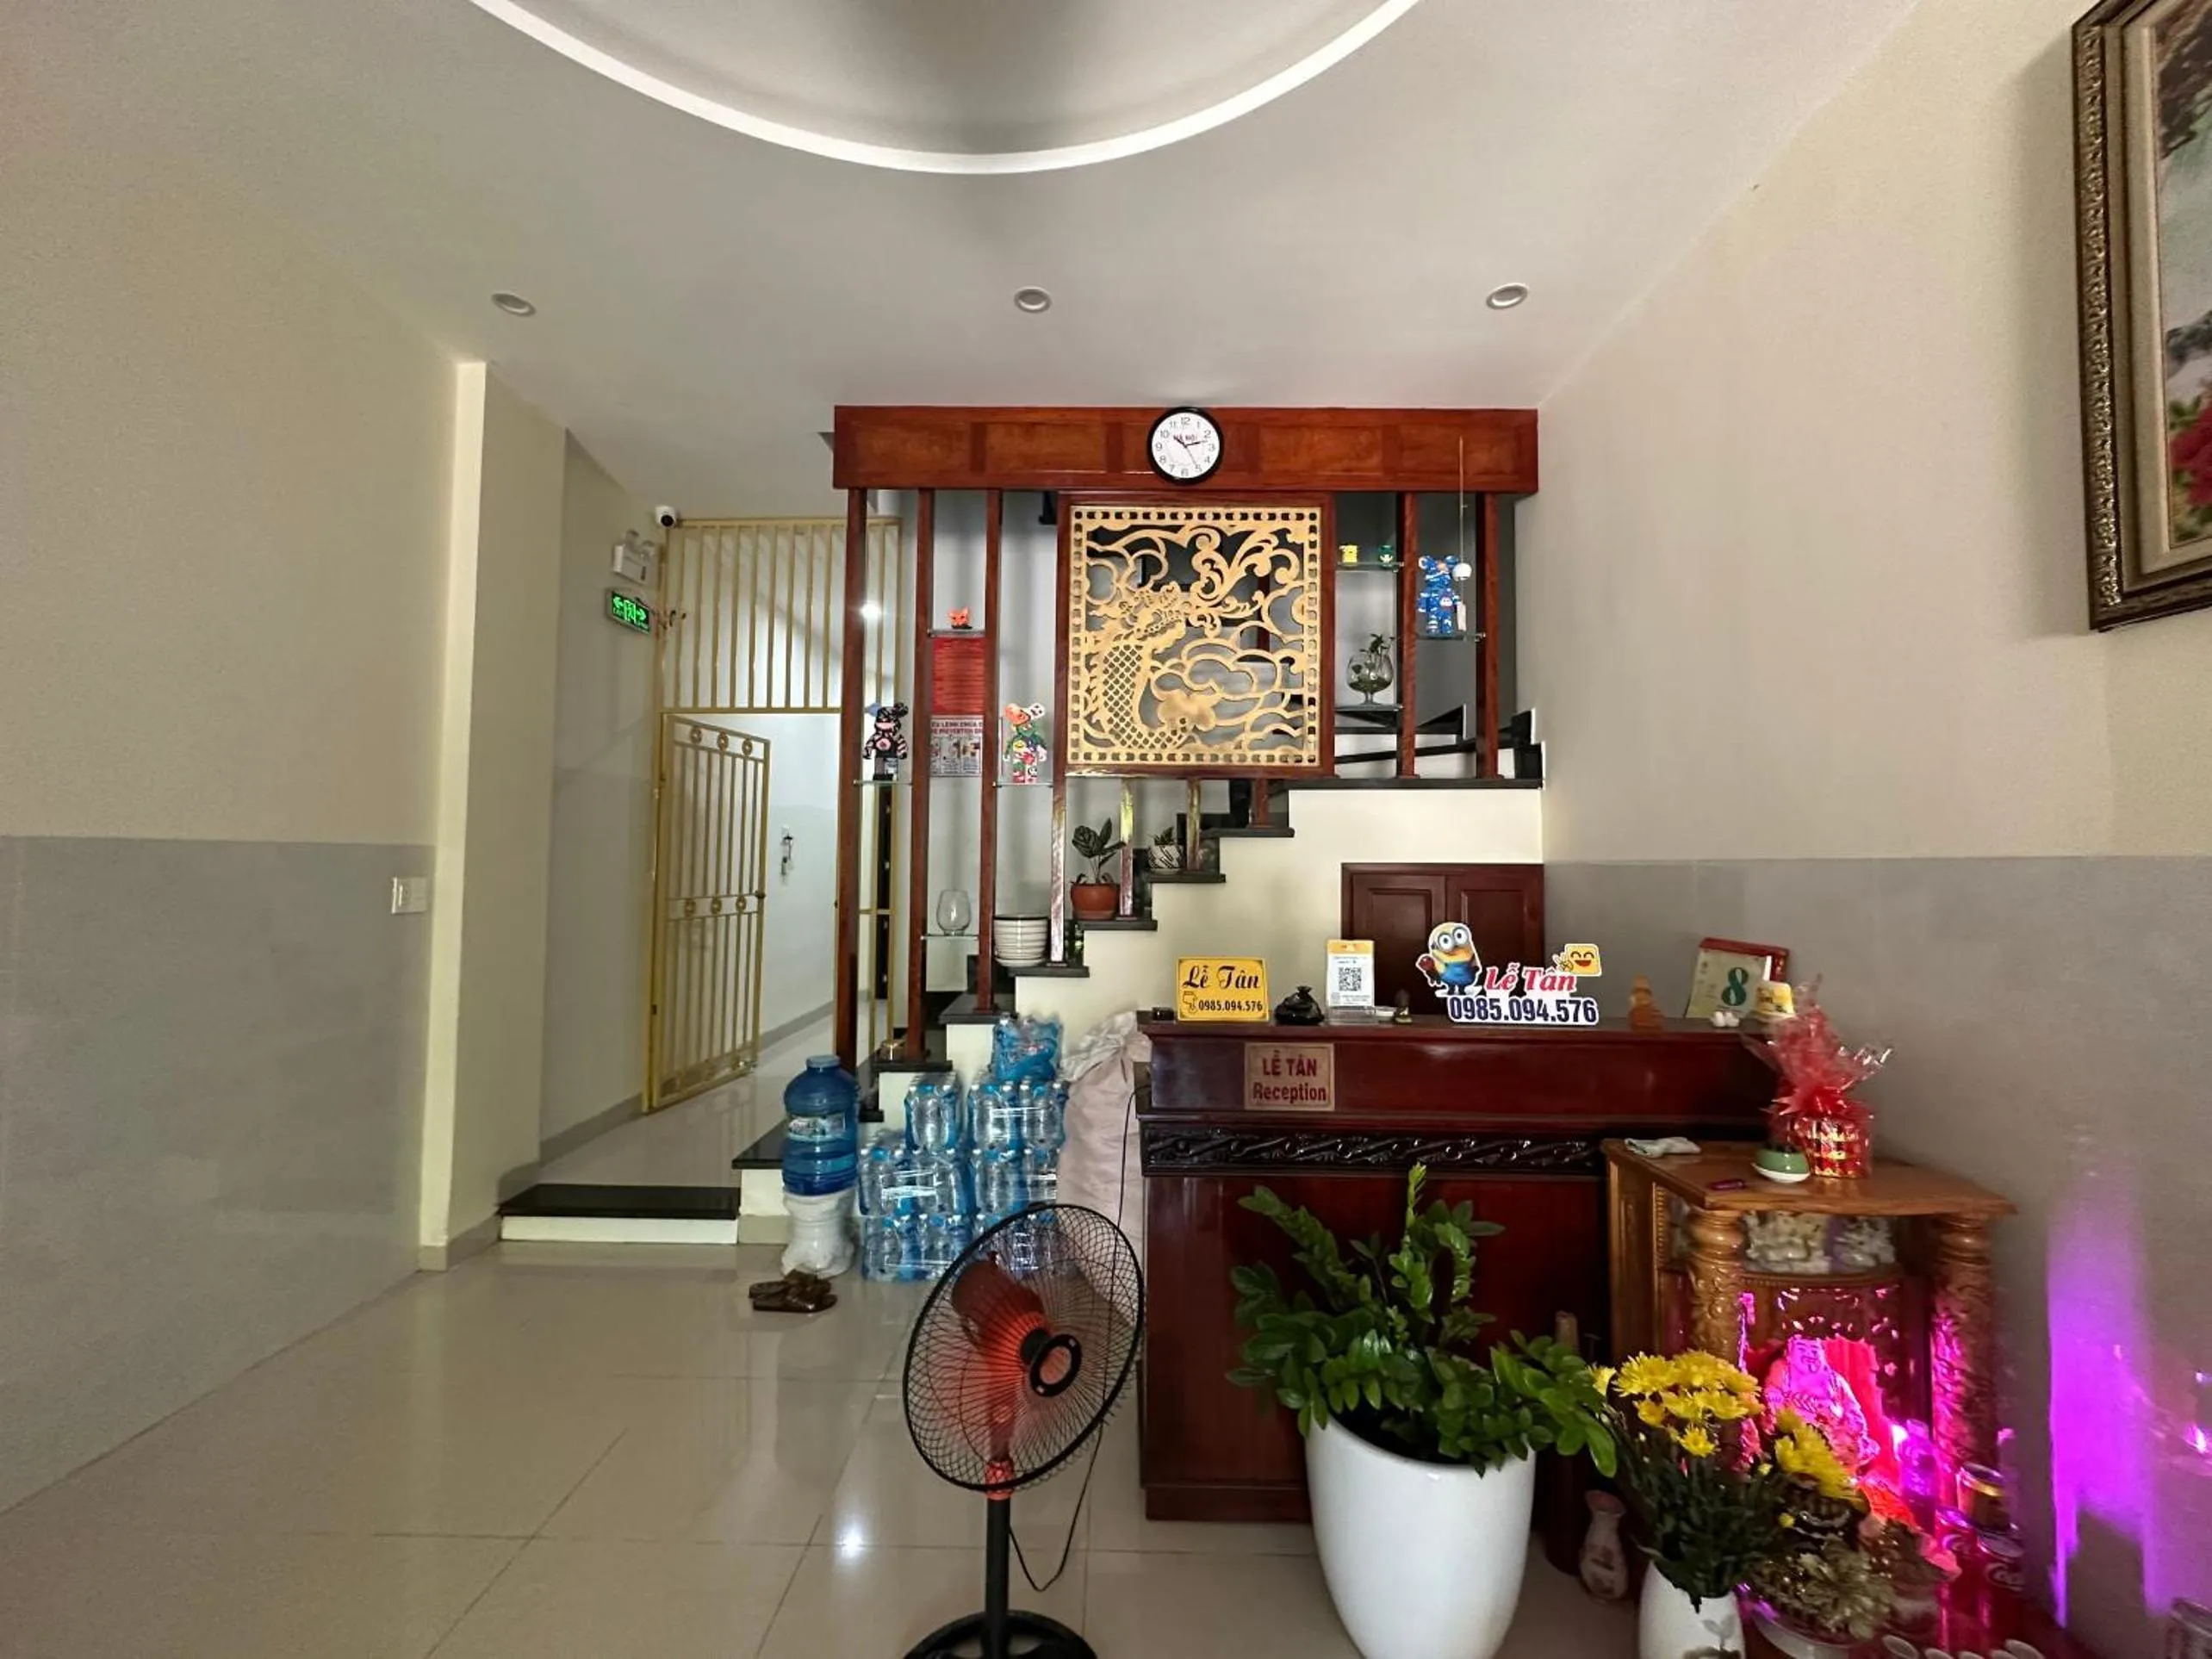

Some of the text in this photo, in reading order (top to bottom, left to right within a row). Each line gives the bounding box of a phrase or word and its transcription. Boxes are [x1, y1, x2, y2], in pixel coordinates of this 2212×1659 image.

[1160, 430, 1170, 438] 10
[1204, 429, 1211, 438] 2
[1155, 442, 1162, 451] 9
[1209, 443, 1215, 452] 3
[1215, 966, 1260, 989] Tân
[1486, 963, 1575, 991] Lễ Tân
[1721, 966, 1749, 1006] 8
[1198, 999, 1263, 1011] 0985.094.576
[1449, 997, 1597, 1022] 0985.094.576
[1286, 1053, 1317, 1077] TÂN
[1252, 1082, 1327, 1104] Reception
